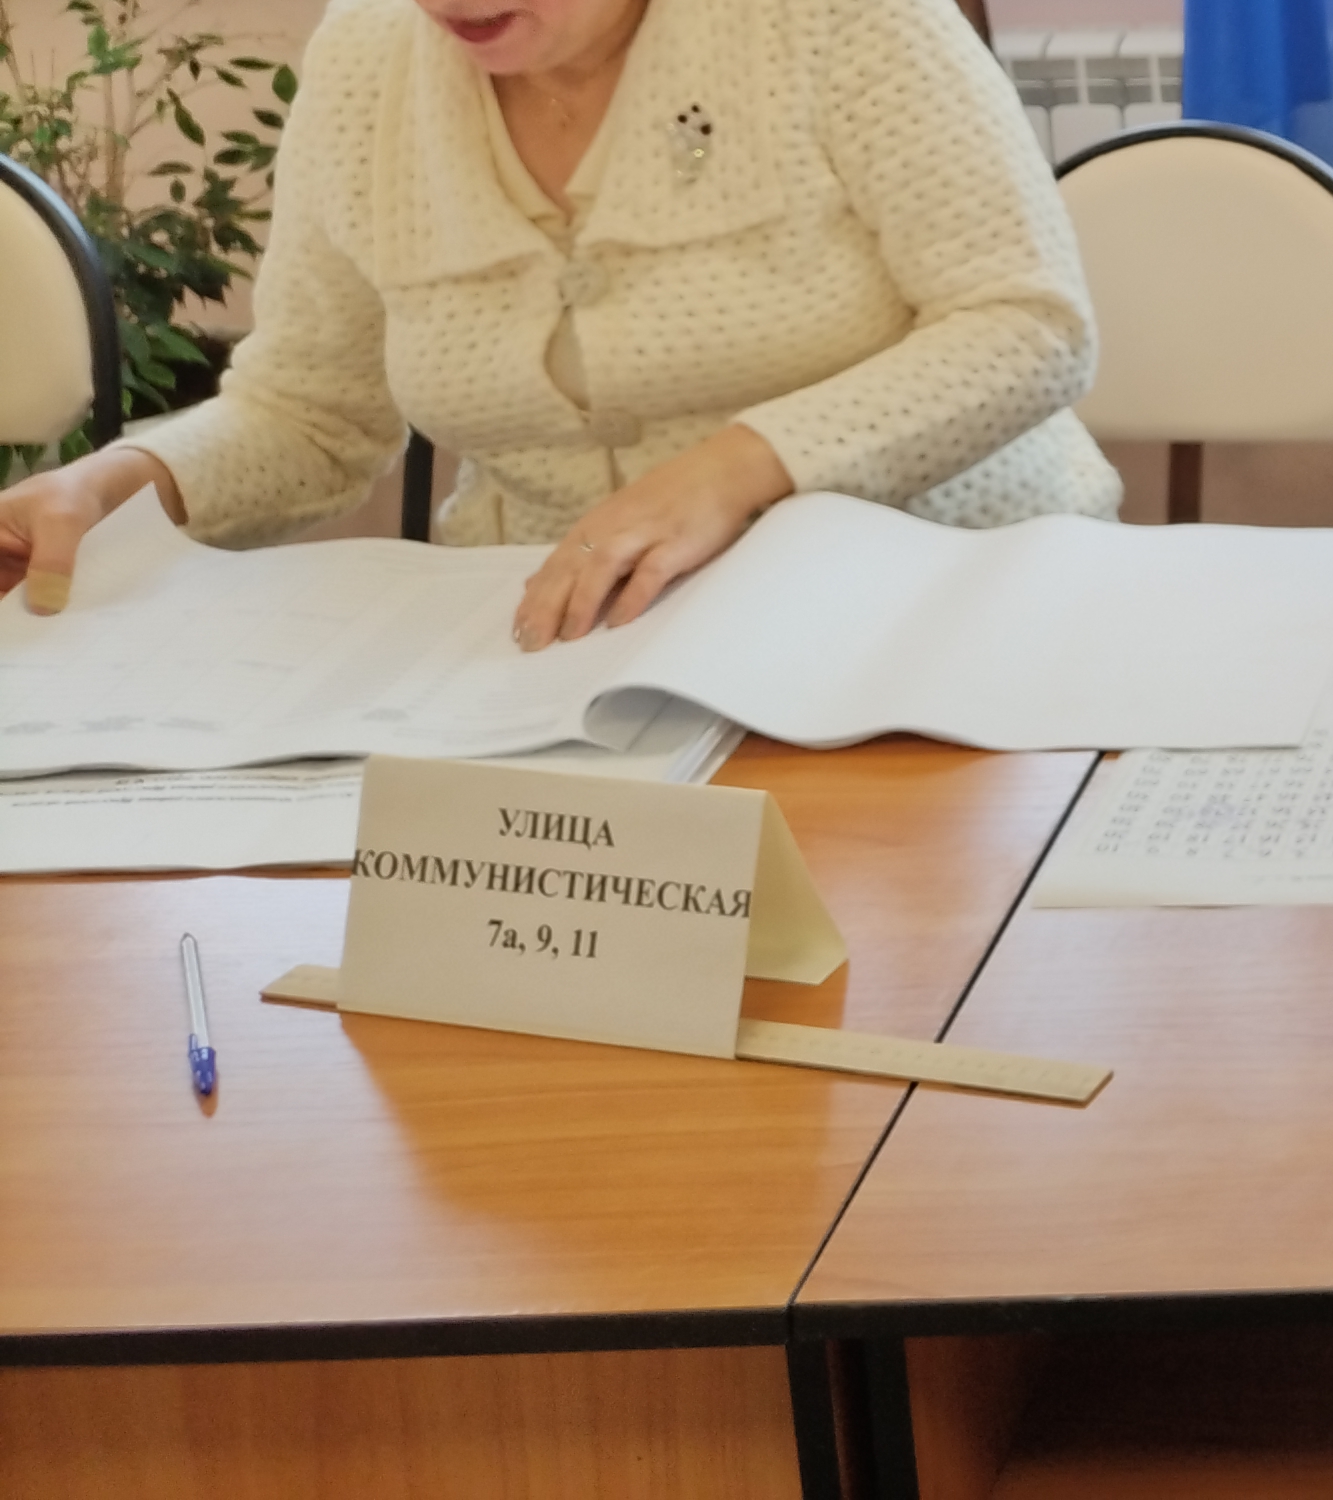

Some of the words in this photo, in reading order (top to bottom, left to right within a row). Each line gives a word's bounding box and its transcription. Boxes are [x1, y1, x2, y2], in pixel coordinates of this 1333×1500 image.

[498, 807, 616, 850] УЛИЦА
[351, 847, 752, 919] КОММУНИСТИЧЕСКАЯ
[486, 918, 527, 953] 7а,
[536, 924, 560, 959] 9,
[571, 929, 600, 959] 11
